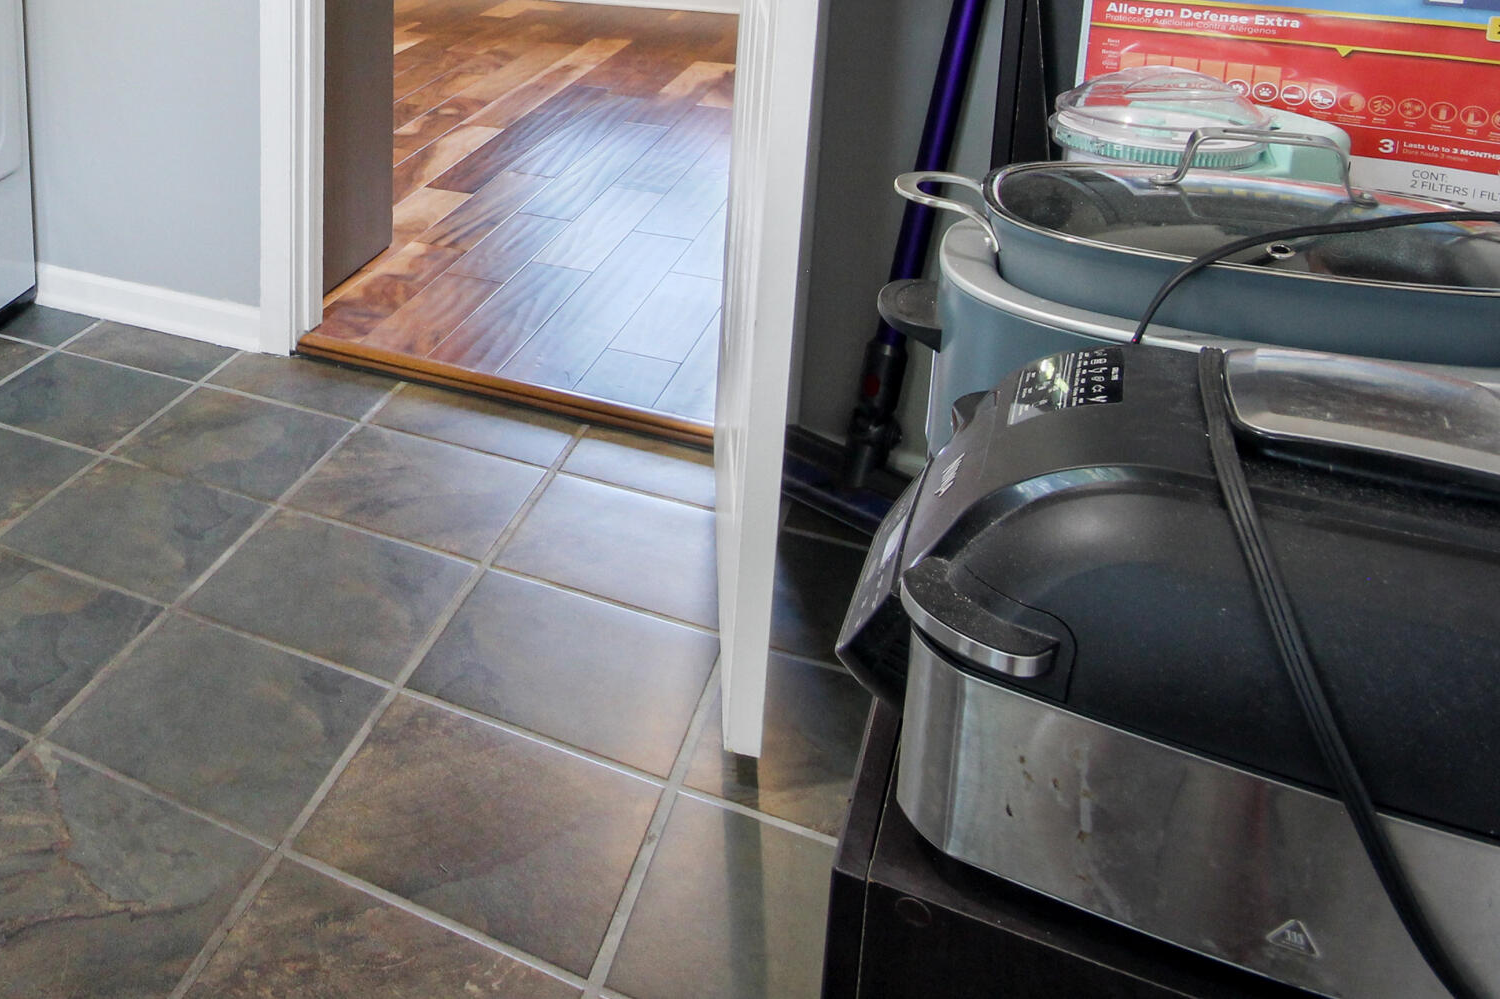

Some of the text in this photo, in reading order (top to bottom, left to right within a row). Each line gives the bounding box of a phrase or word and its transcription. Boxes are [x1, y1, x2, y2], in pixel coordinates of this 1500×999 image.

[1106, 2, 1300, 29] Allergen Defense Extra
[1152, 17, 1194, 27] Adicional
[1196, 20, 1226, 30] Contra
[1378, 138, 1395, 154] 3
[1428, 144, 1440, 152] Up
[1460, 149, 1500, 160] MONTHS
[1411, 169, 1448, 183] CONT:
[1410, 180, 1417, 189] 2
[1420, 180, 1468, 197] FILTERS
